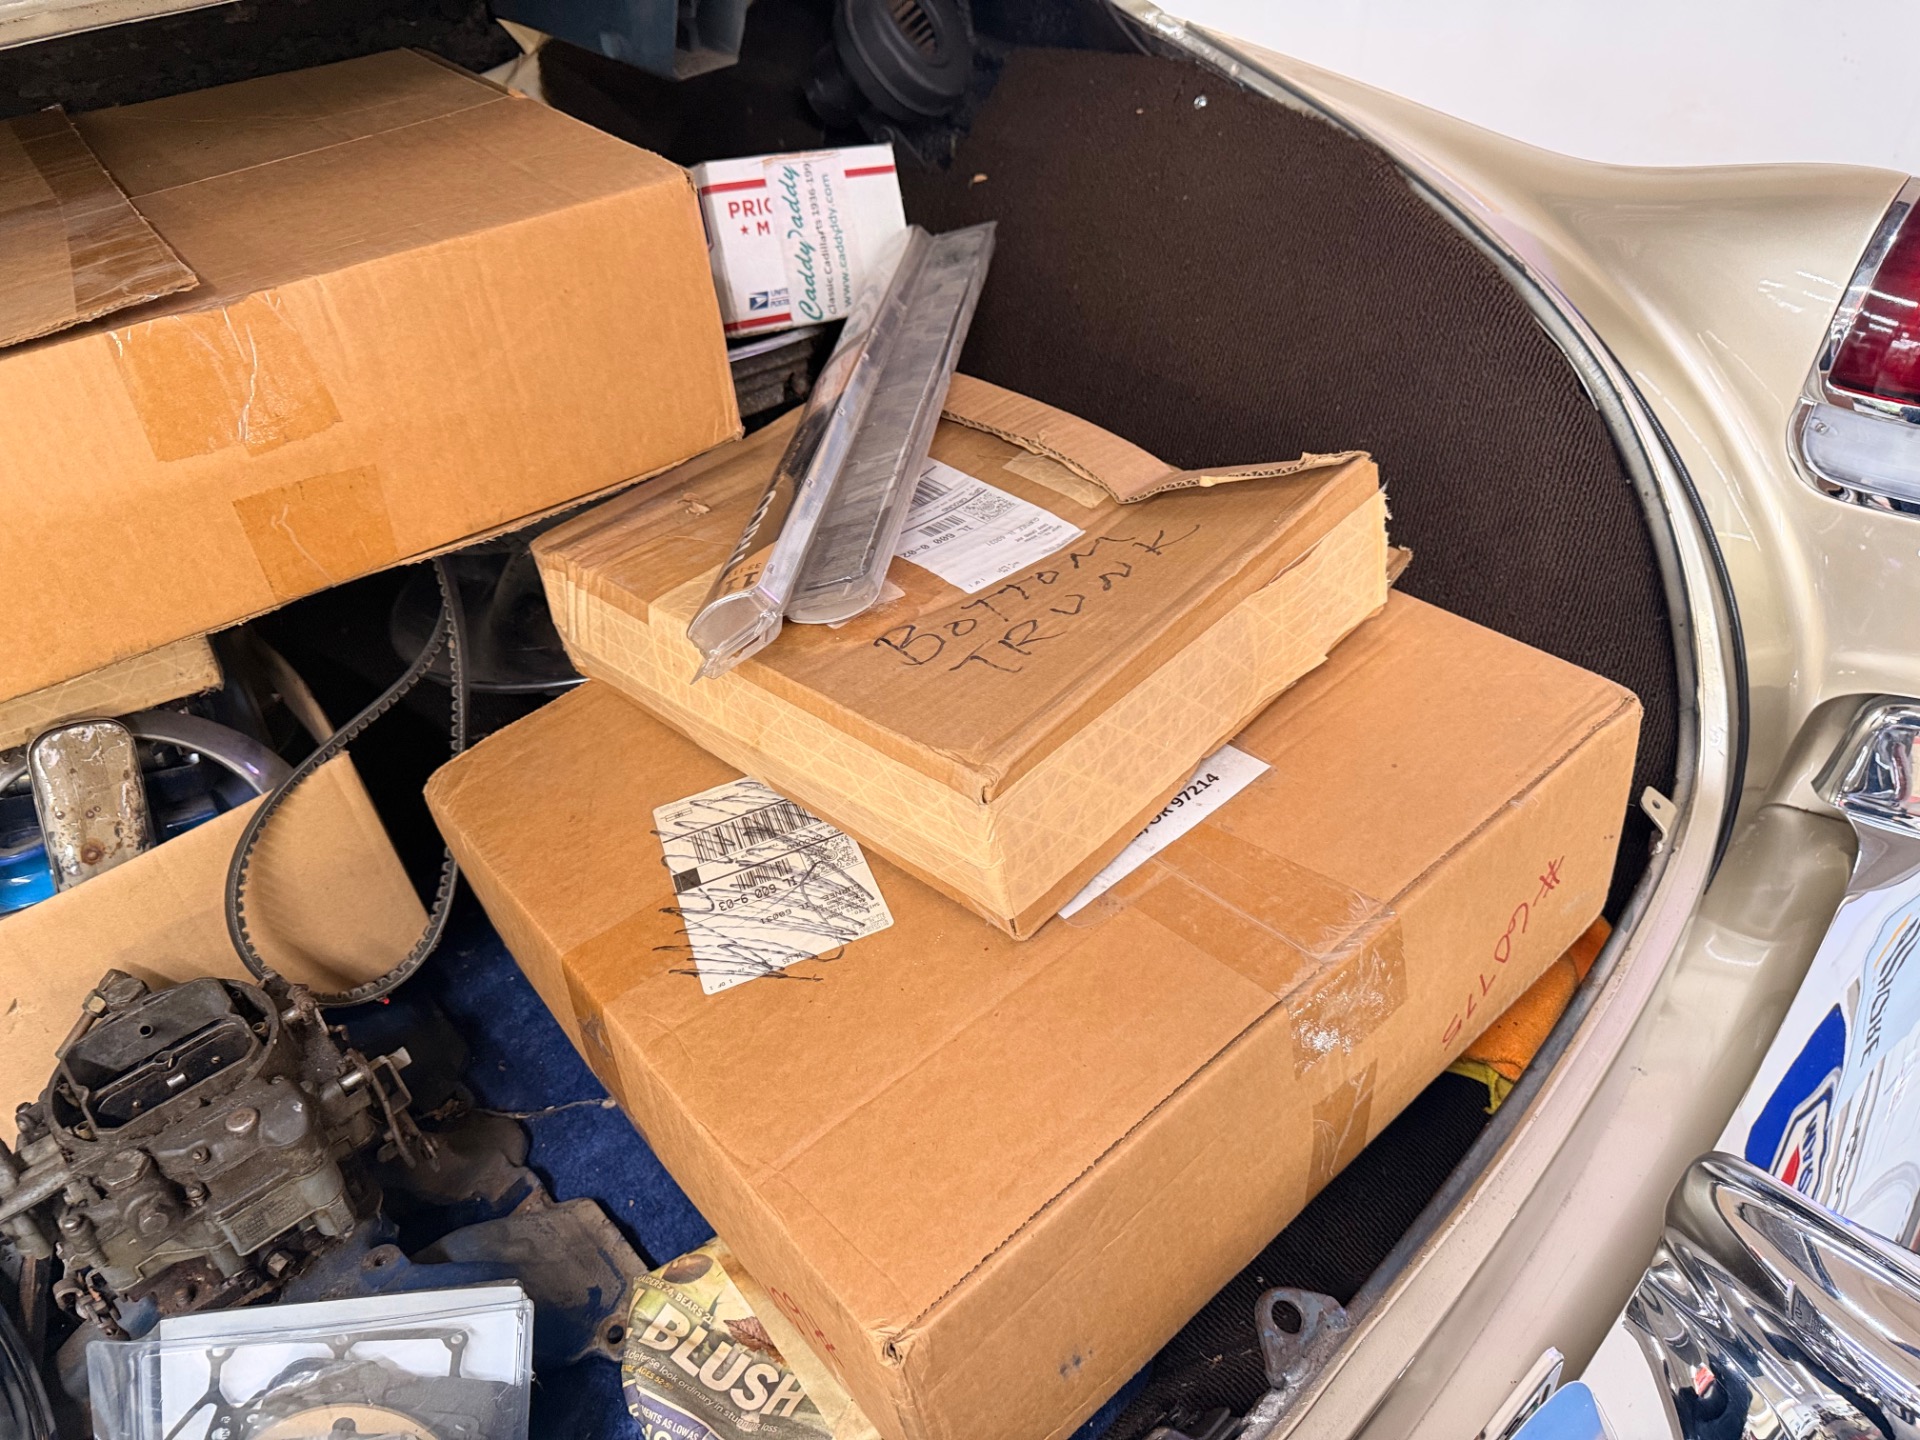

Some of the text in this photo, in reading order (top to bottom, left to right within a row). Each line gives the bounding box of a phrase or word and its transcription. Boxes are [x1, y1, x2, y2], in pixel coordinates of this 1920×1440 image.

[757, 220, 771, 236] M
[771, 287, 789, 296] UNITE
[795, 241, 824, 321] Caddy
[828, 277, 836, 315] Classic
[948, 523, 1201, 674] TRUNK
[1170, 772, 1220, 809] 97214
[718, 875, 797, 912] IL 600 9-03
[675, 1292, 703, 1318] BEARS
[702, 1311, 714, 1323] 21
[637, 1302, 808, 1418] BLUSH
[659, 1364, 680, 1384] look
[678, 1379, 715, 1408] ordinary
[714, 1399, 726, 1413] in
[661, 1417, 672, 1430] AS
[672, 1422, 690, 1438] LOW
